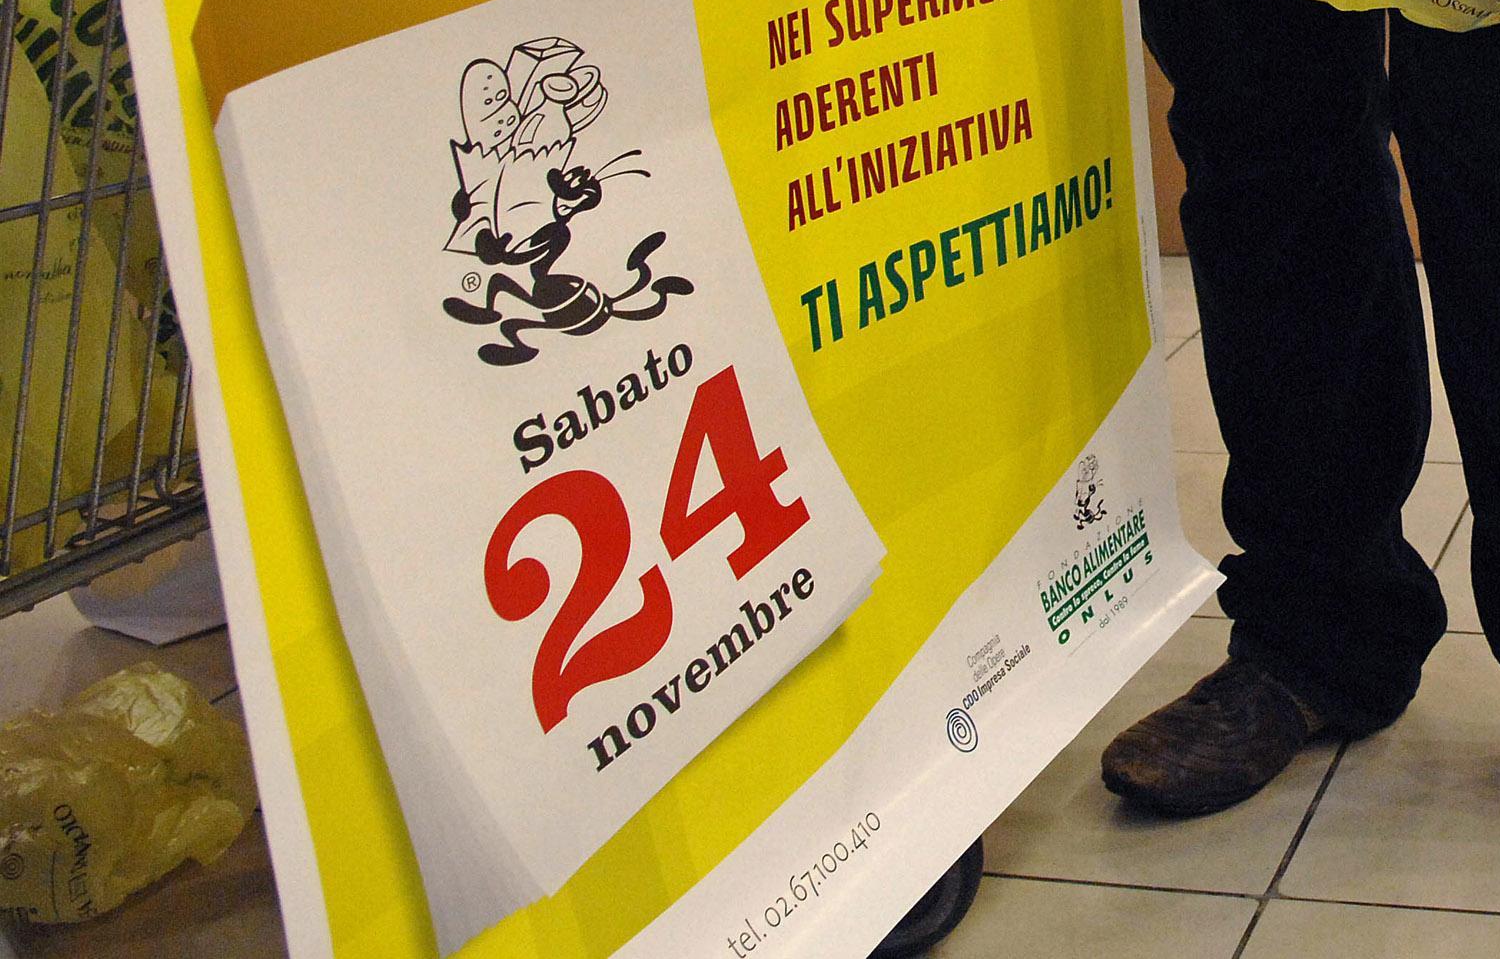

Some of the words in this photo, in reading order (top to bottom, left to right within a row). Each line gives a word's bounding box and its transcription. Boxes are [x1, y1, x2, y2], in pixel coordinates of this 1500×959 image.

[766, 7, 812, 70] NEI
[775, 51, 939, 153] ADERENTI
[787, 97, 1034, 233] ALL'INIZIATIVA
[800, 278, 844, 353] TI
[858, 157, 1113, 330] ASPETTIAMO!
[512, 343, 694, 474] Sabato
[484, 364, 811, 735] 24
[1040, 564, 1082, 614] BANCO
[1082, 509, 1147, 579] ALIMENTARE
[586, 567, 815, 773] novembre
[962, 689, 980, 710] CDO
[977, 667, 1007, 696] Impresa
[1004, 643, 1031, 672] Sociale
[727, 918, 767, 959] tel.
[764, 812, 881, 927] 02.67.100.410
